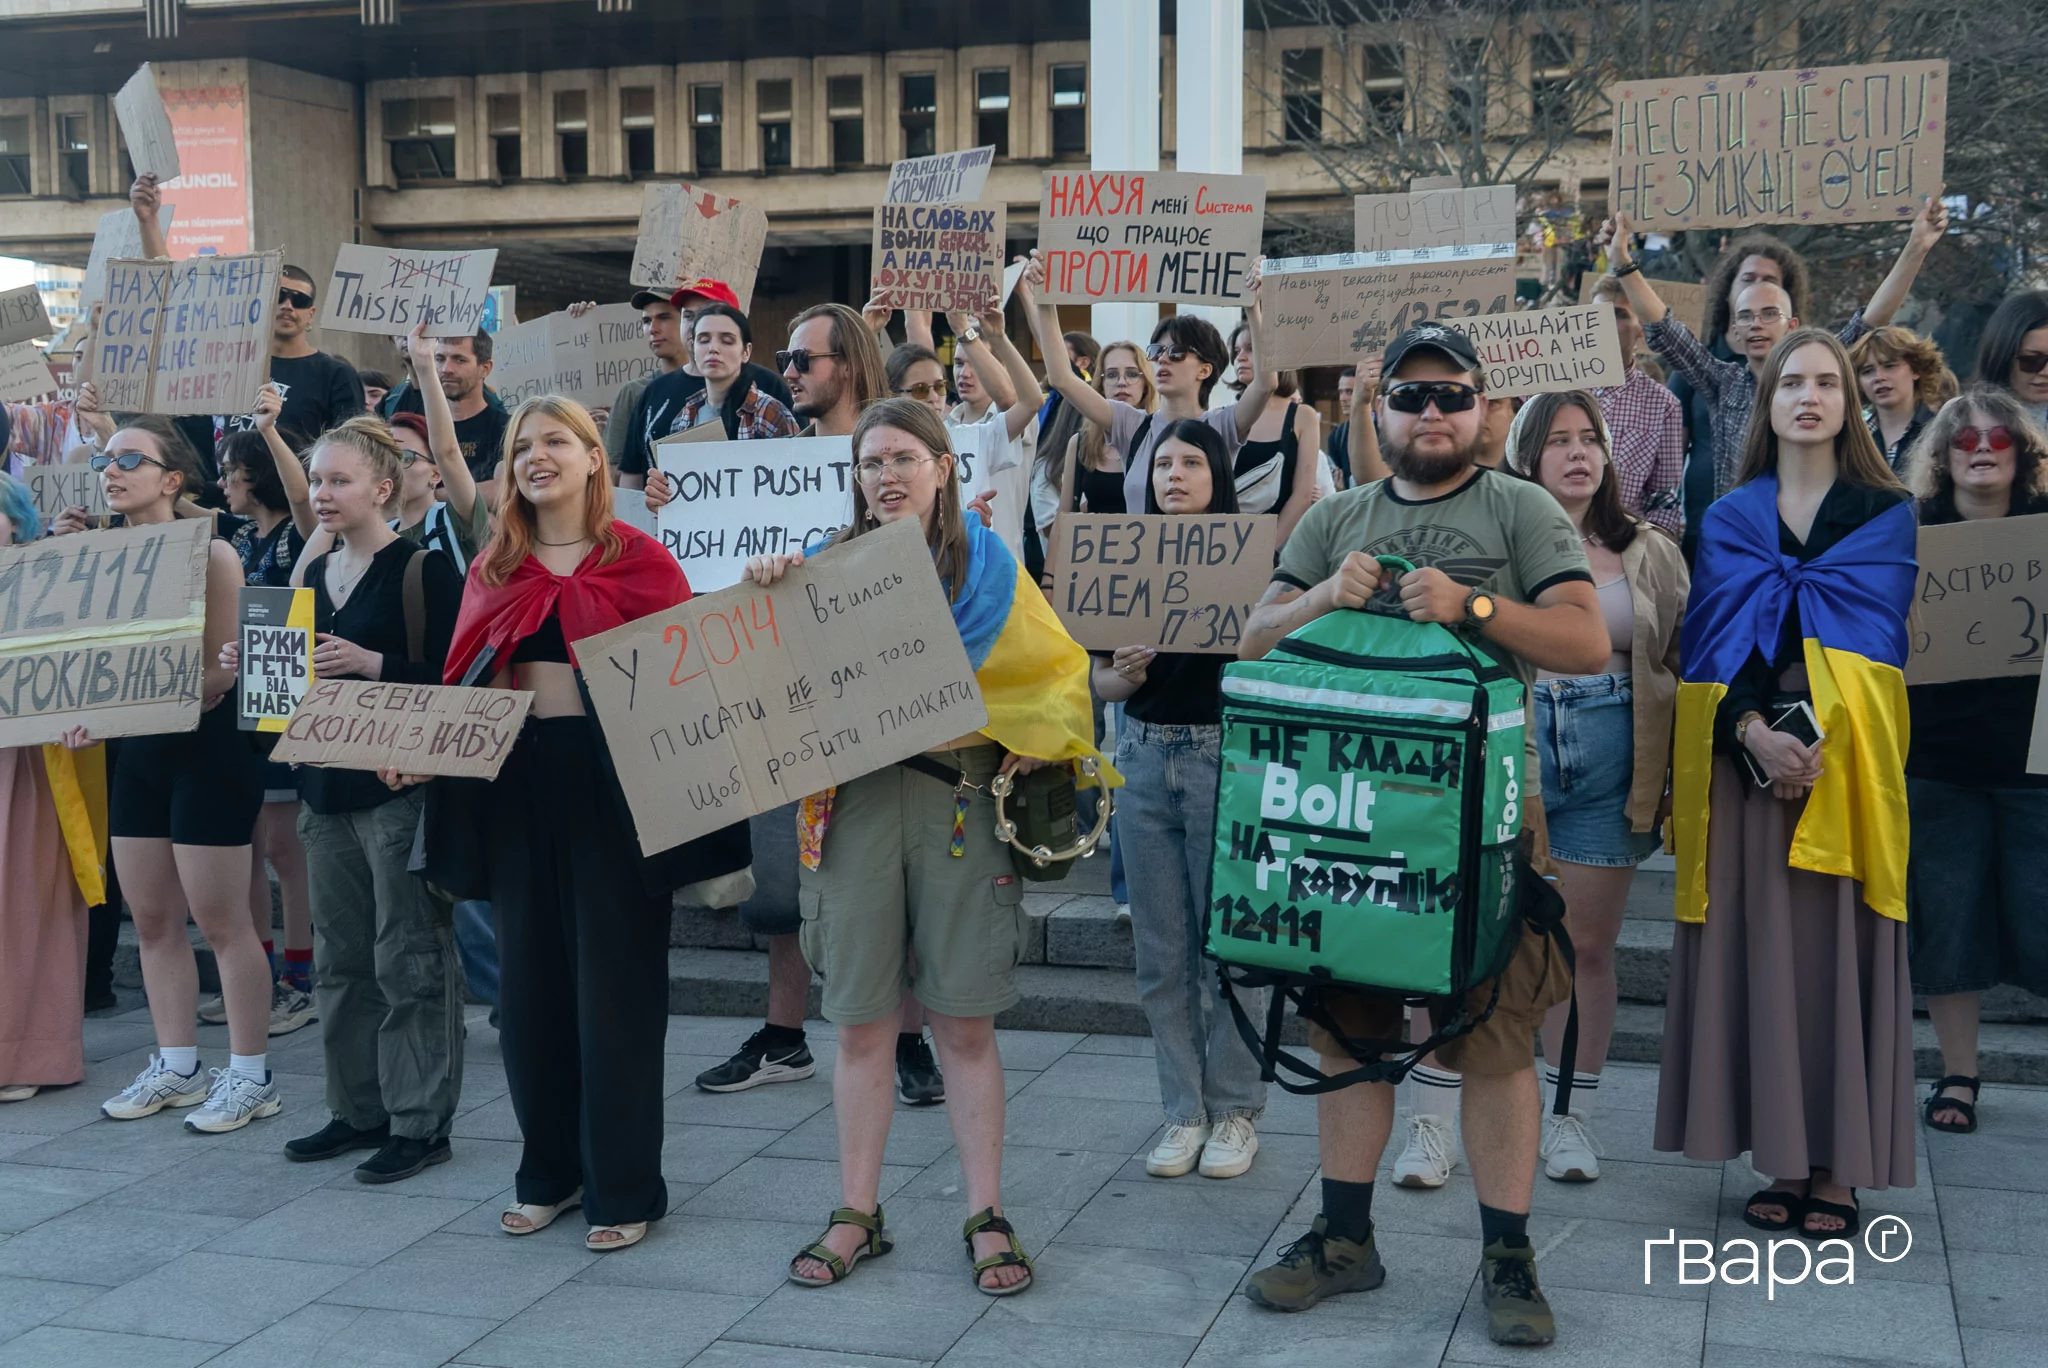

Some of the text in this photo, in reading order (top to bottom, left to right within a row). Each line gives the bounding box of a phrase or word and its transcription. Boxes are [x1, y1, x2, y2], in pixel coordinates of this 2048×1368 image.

[1780, 83, 1818, 148] НЕ
[1838, 73, 1928, 143] СПИ
[1050, 174, 1145, 218] НАХУЯ
[1195, 185, 1253, 215] Система
[1617, 163, 1655, 221] НЕ
[882, 206, 996, 233] НА СЛОВАХ
[1076, 225, 1212, 246] ЩО ПРАЦЮЄ
[881, 229, 936, 250] ВОНИ
[389, 258, 462, 288] 12414
[881, 269, 992, 291] ОХУЇВША
[882, 251, 897, 269] А
[905, 251, 933, 270] НА
[1044, 250, 1148, 296] ПРОТИ
[1156, 251, 1247, 298] МЕНЕ
[109, 266, 198, 304] НАХУЯ
[335, 271, 385, 321] This
[415, 294, 446, 325] the
[230, 298, 261, 327] ЩО
[205, 340, 257, 365] ПРОТИ
[1551, 339, 1562, 356] А
[1571, 333, 1598, 352] НЕ
[663, 467, 743, 503] DONT
[754, 464, 821, 497] PUSH
[662, 528, 724, 561] PUSH
[1071, 521, 1254, 566] БЕЗ НАБУ
[1067, 570, 1189, 618] ІДЕМ В
[247, 629, 306, 656] РУКИ
[609, 648, 638, 711] У
[663, 594, 780, 686] 2014
[247, 654, 306, 678] ГЕТЬ
[266, 677, 289, 693] ВІД
[247, 691, 305, 715] НАБУ
[307, 682, 344, 706] Я
[464, 691, 516, 722] ЩО
[650, 697, 766, 762] ПИСАТИ
[786, 675, 813, 706] НЕ
[878, 638, 925, 668] того
[286, 713, 400, 749] СКОЇЛИ
[428, 721, 509, 762] НАБУ
[766, 730, 861, 786] робити
[1249, 727, 1464, 788] НЕ КЛАДИ
[1260, 762, 1376, 832] Bolt
[1497, 756, 1518, 844] Food
[1230, 820, 1277, 865] НА
